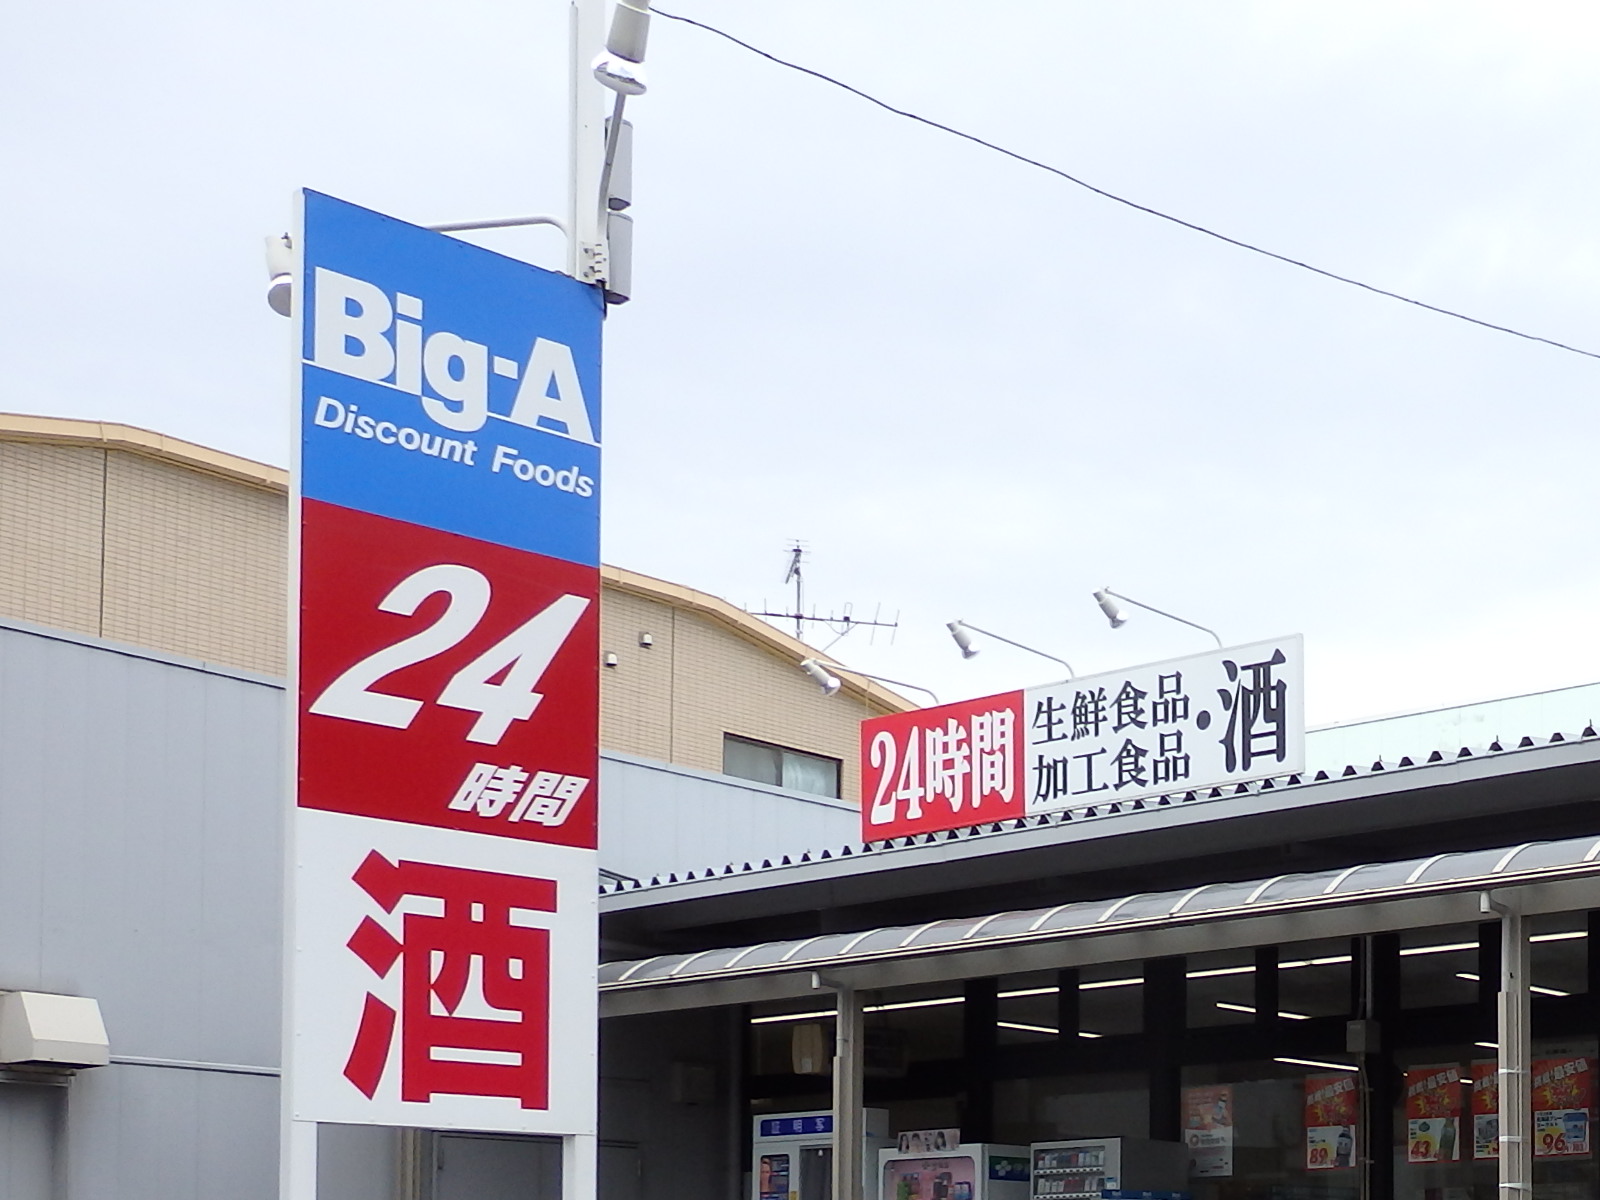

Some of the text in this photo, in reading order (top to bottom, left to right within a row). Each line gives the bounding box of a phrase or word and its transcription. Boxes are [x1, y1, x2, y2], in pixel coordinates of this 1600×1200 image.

[313, 265, 597, 445] Big-A
[313, 395, 595, 498] Discount Foods
[308, 562, 592, 746] 24
[1031, 670, 1190, 746] 生鮮食品
[447, 761, 591, 827] 時間
[869, 706, 1016, 827] 24時間
[1031, 729, 1191, 806] 加工食品
[342, 848, 559, 1111] 酒
